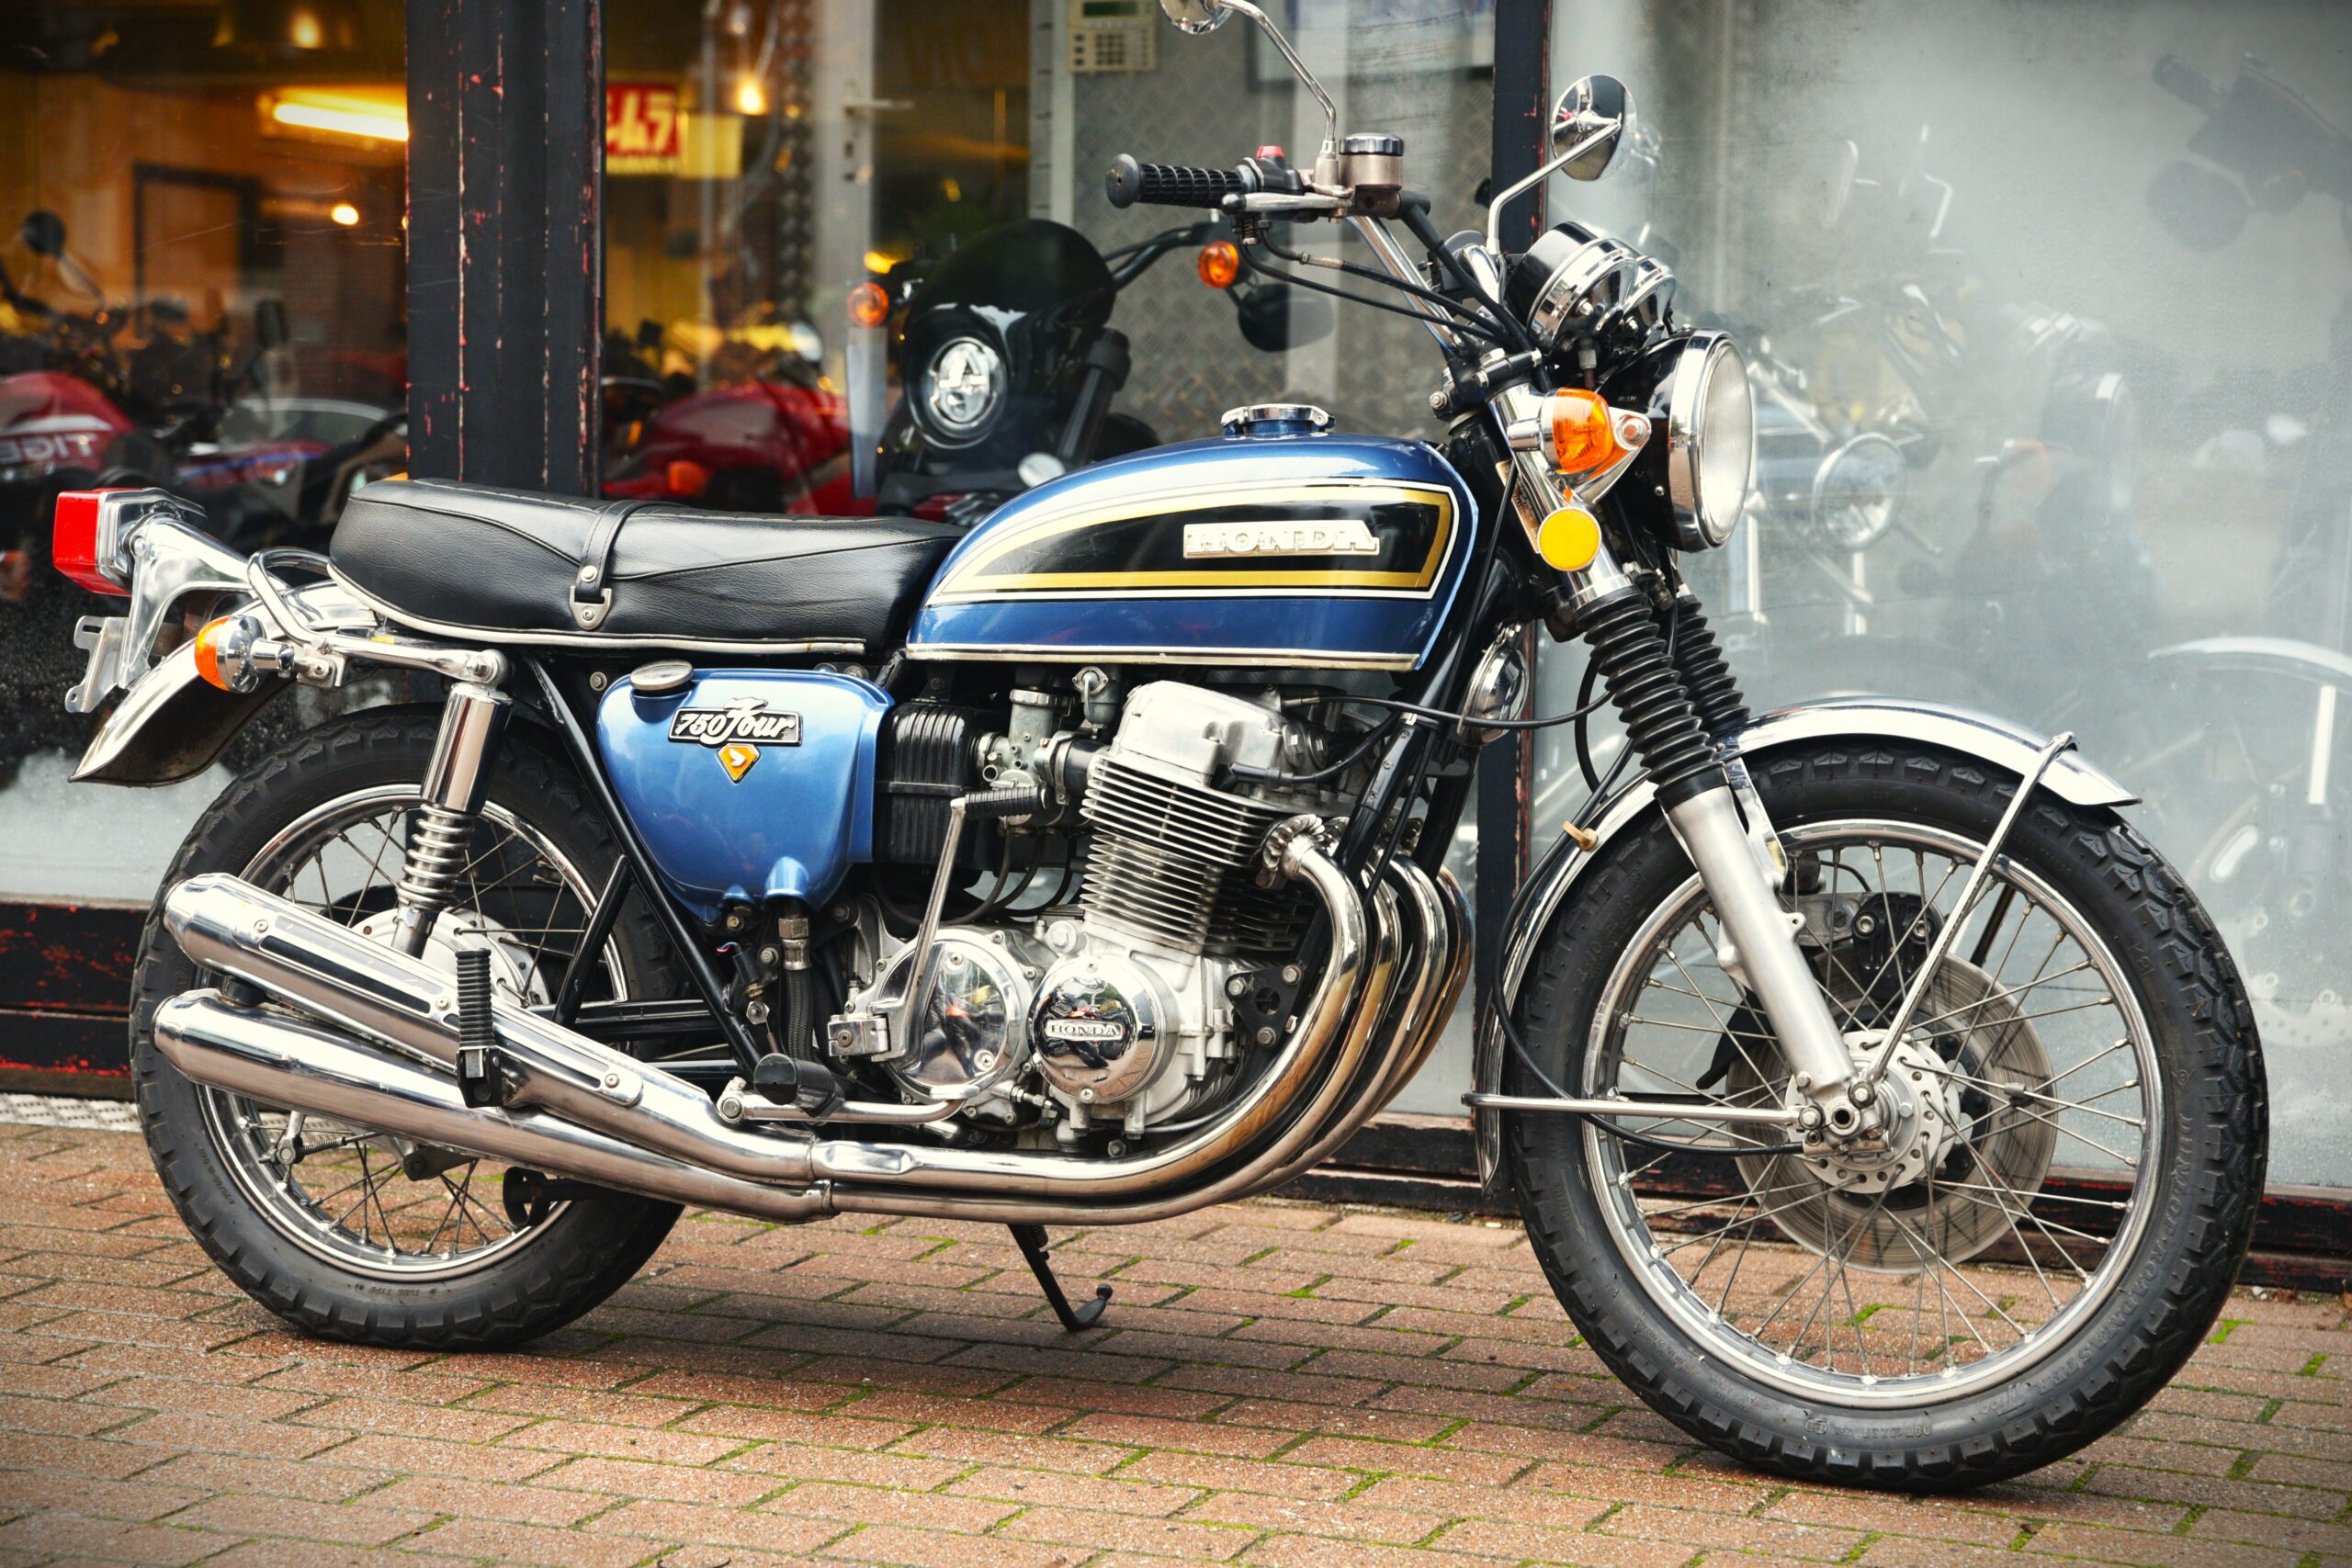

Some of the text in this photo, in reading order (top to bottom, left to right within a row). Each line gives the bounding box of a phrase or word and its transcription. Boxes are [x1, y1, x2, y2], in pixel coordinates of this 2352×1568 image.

[1186, 528, 1377, 557] HONDA
[1050, 1024, 1119, 1036] HONDA
[2165, 1112, 2194, 1236] DUNLOP
[368, 1286, 392, 1296] TYPE
[2037, 1238, 2167, 1397] ROADMASTER
